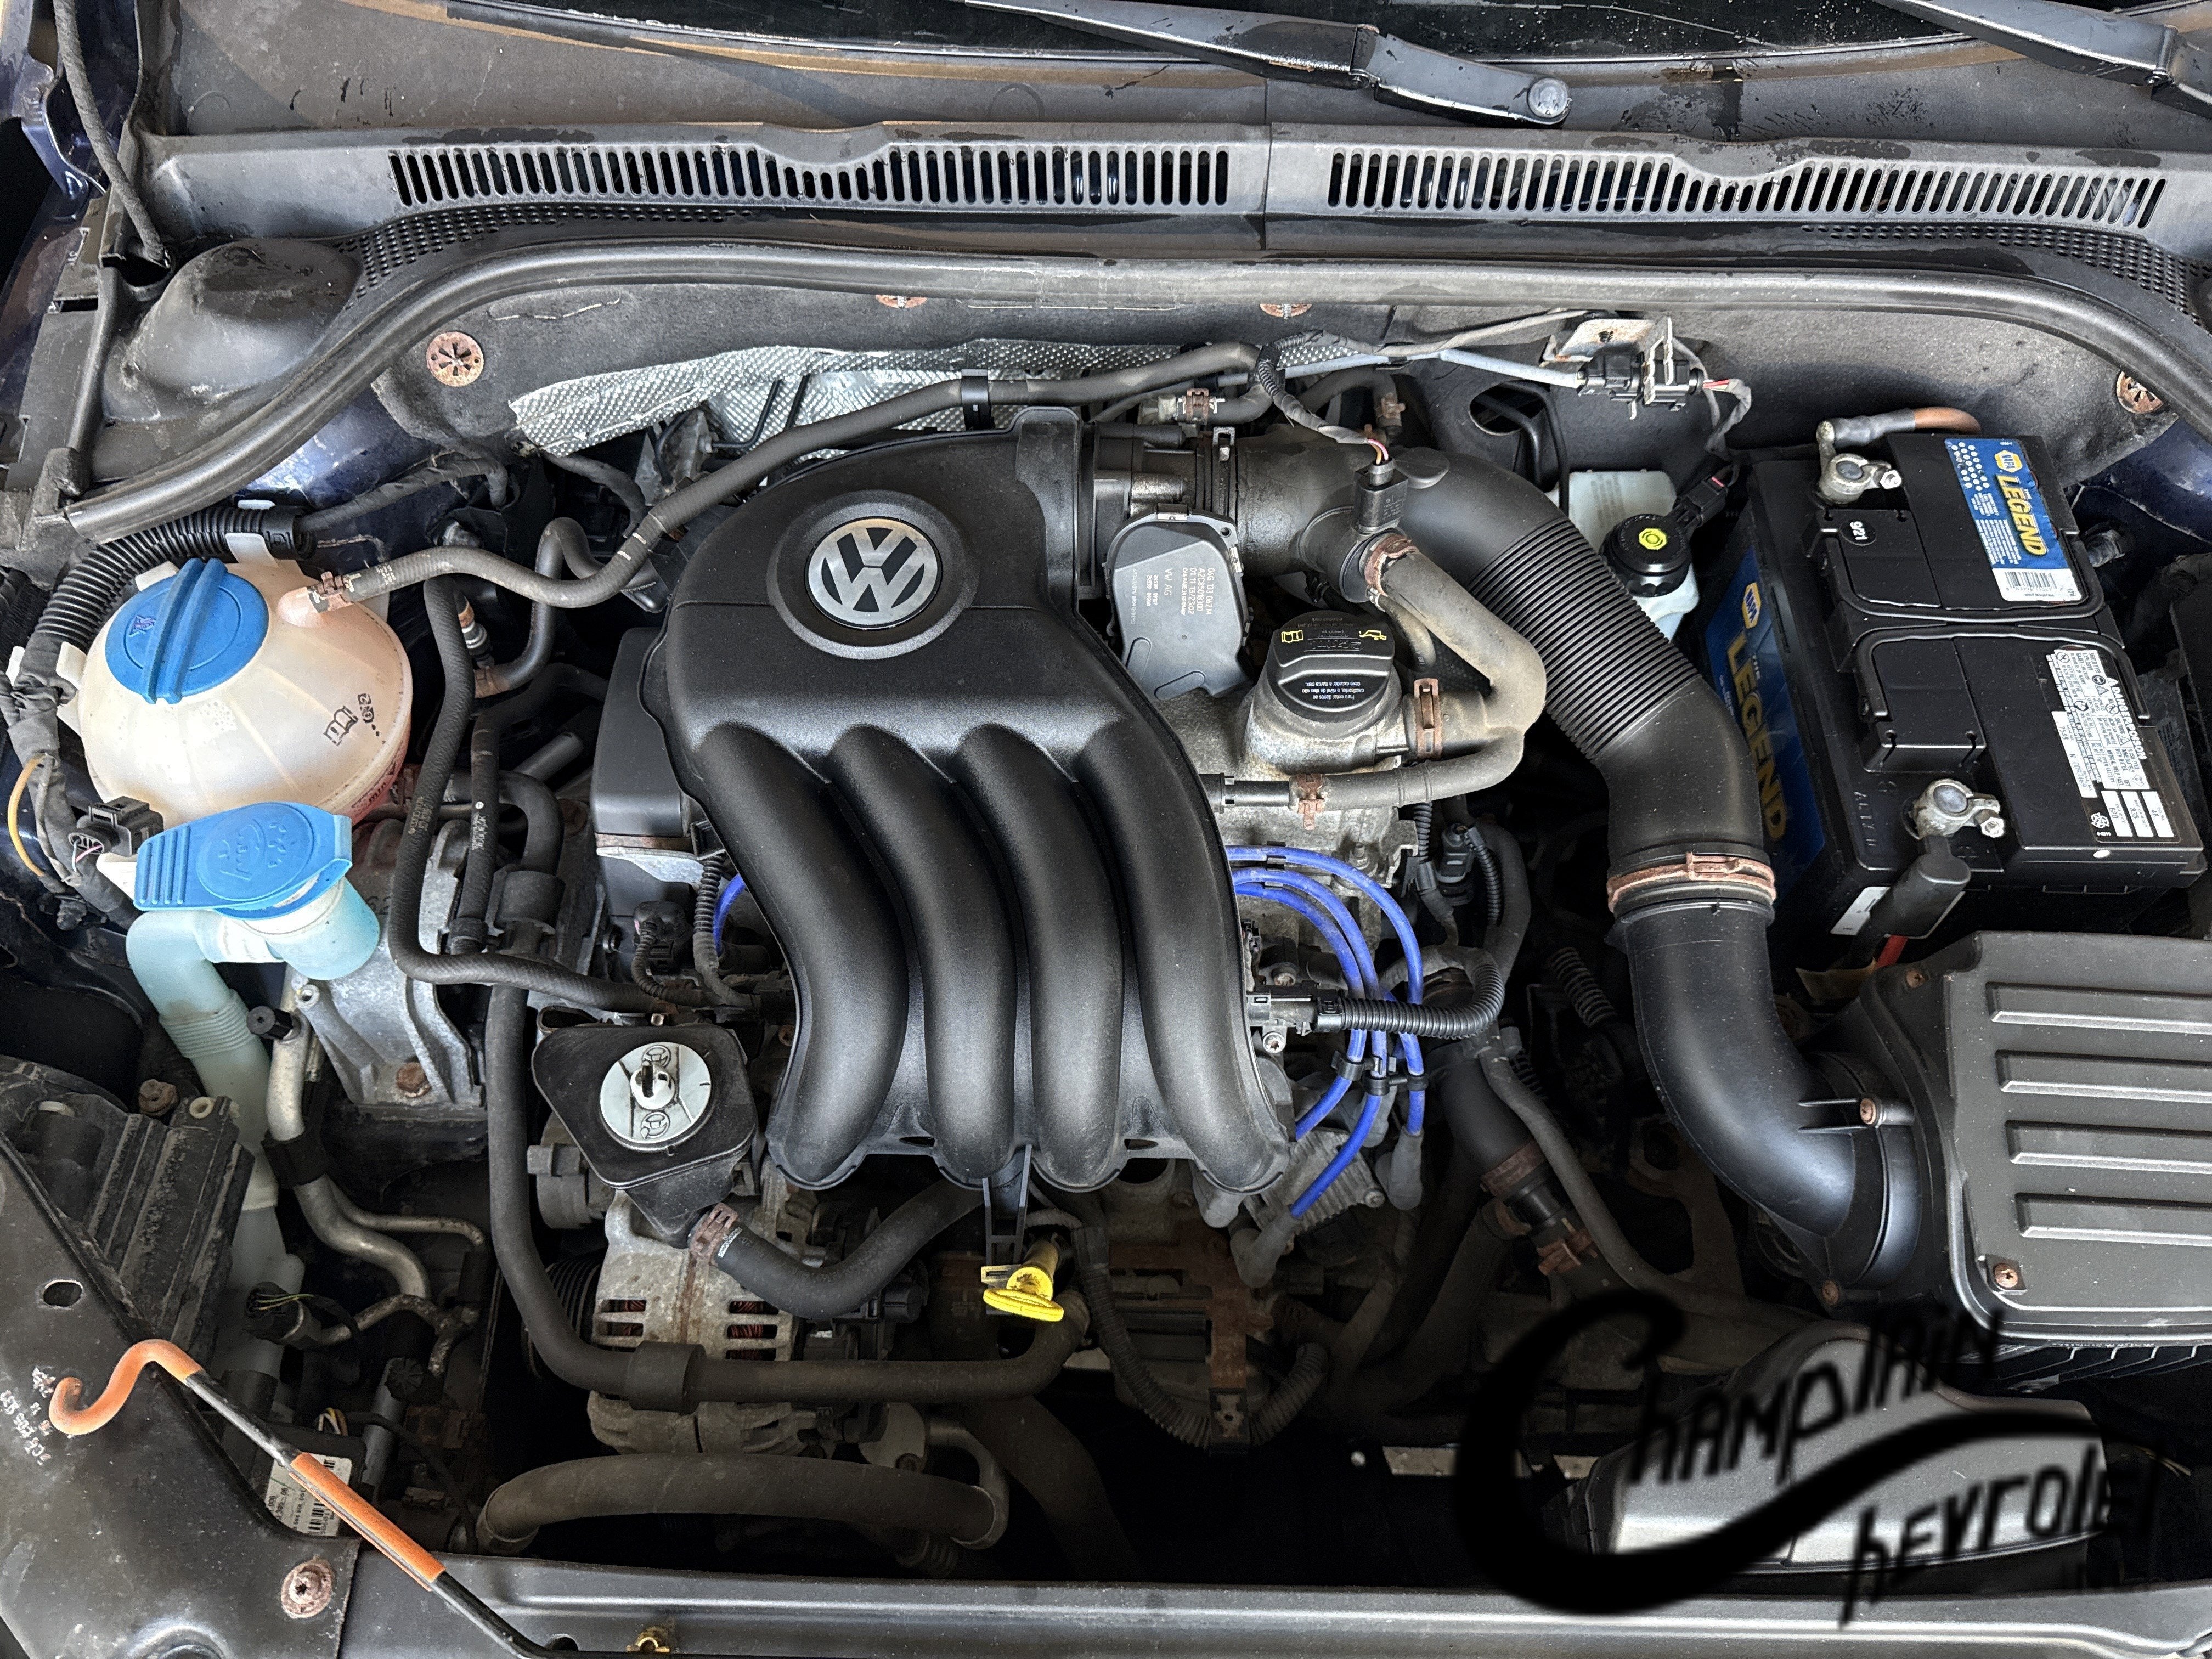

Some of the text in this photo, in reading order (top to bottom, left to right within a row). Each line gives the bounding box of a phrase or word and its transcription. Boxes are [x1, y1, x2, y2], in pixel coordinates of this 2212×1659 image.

[2001, 454, 2016, 469] NAPA
[1995, 475, 2048, 555] LEGEND
[1849, 520, 1867, 541] 9/21
[1164, 568, 1173, 596] VW AG
[1745, 589, 1758, 623] NAPA
[1727, 629, 1787, 841] LEGEND
[2111, 687, 2147, 759] DANGER/POISON
[2108, 807, 2119, 818] 680
[2129, 808, 2140, 819] 835
